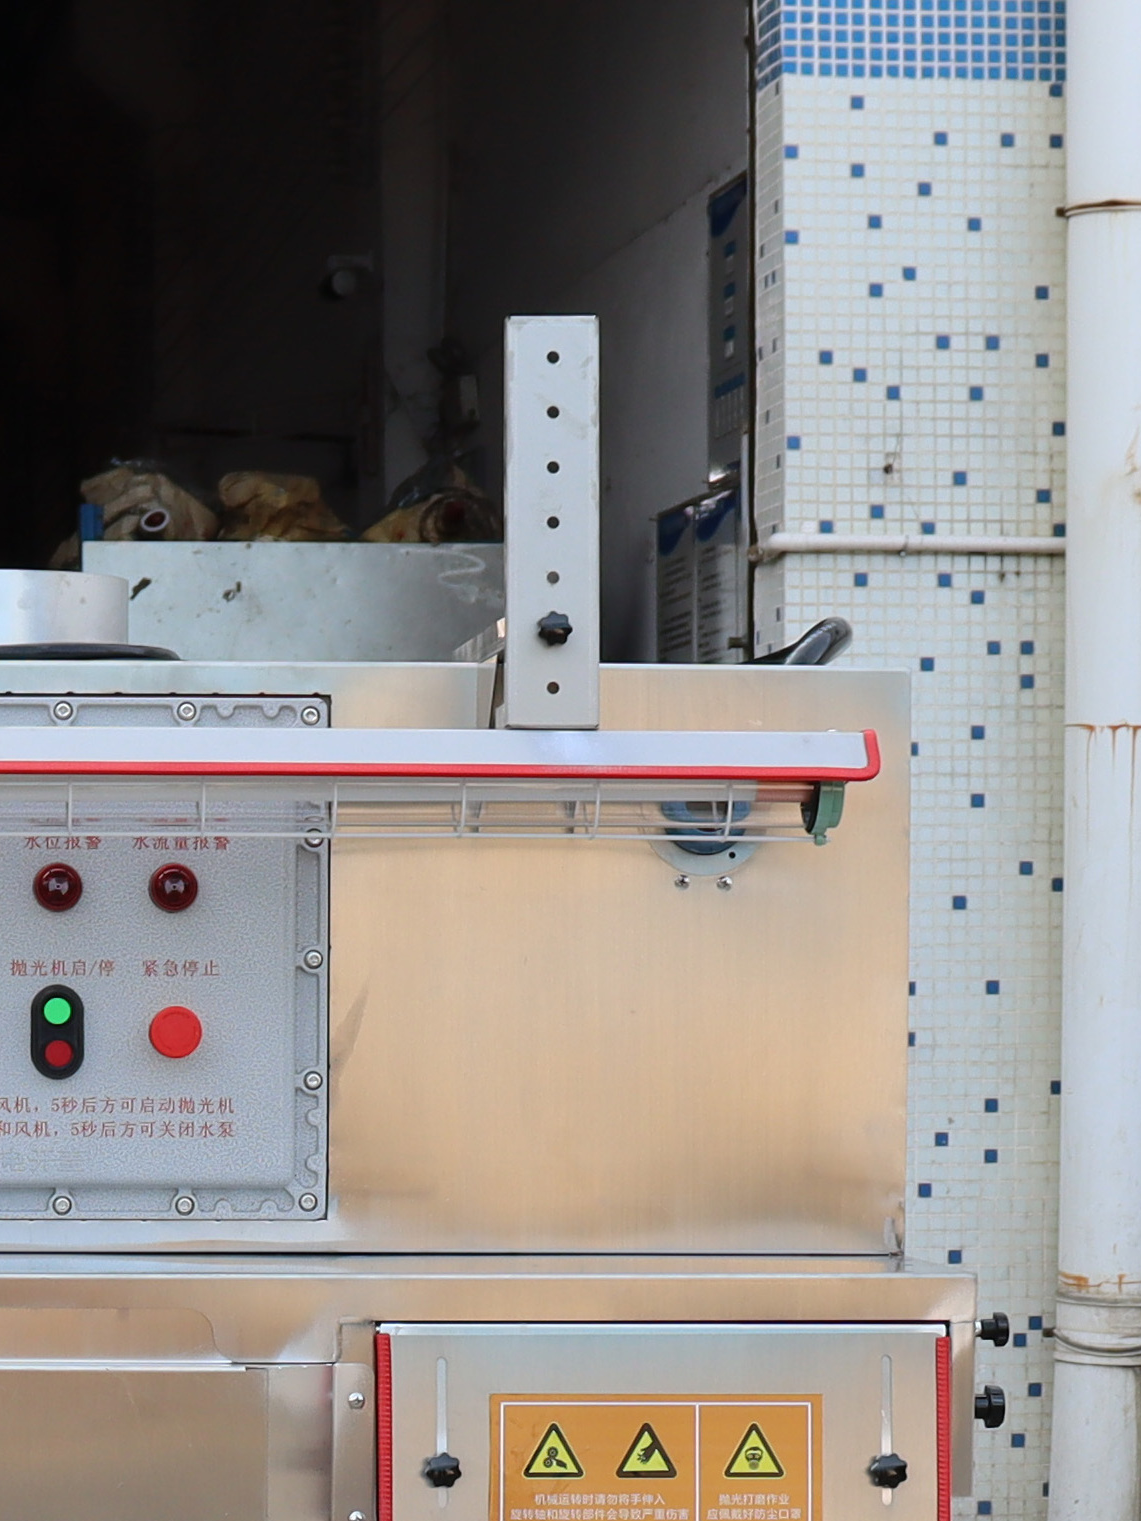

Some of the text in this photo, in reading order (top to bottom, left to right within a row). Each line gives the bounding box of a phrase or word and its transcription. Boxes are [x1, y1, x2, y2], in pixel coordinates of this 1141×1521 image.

[24, 836, 102, 850] 水位报警
[132, 836, 231, 851] 水流量报警
[10, 958, 116, 977] 抛光机启/停
[142, 958, 220, 977] 紧急停止
[534, 1493, 666, 1506] 机械运转时请勿将手伸入
[718, 1493, 790, 1506] 抛光打磨作业
[510, 1508, 690, 1521] 旋转轴和旋转部件会导致严重伤害
[706, 1508, 802, 1520] 应佩戴好防尘口罩
